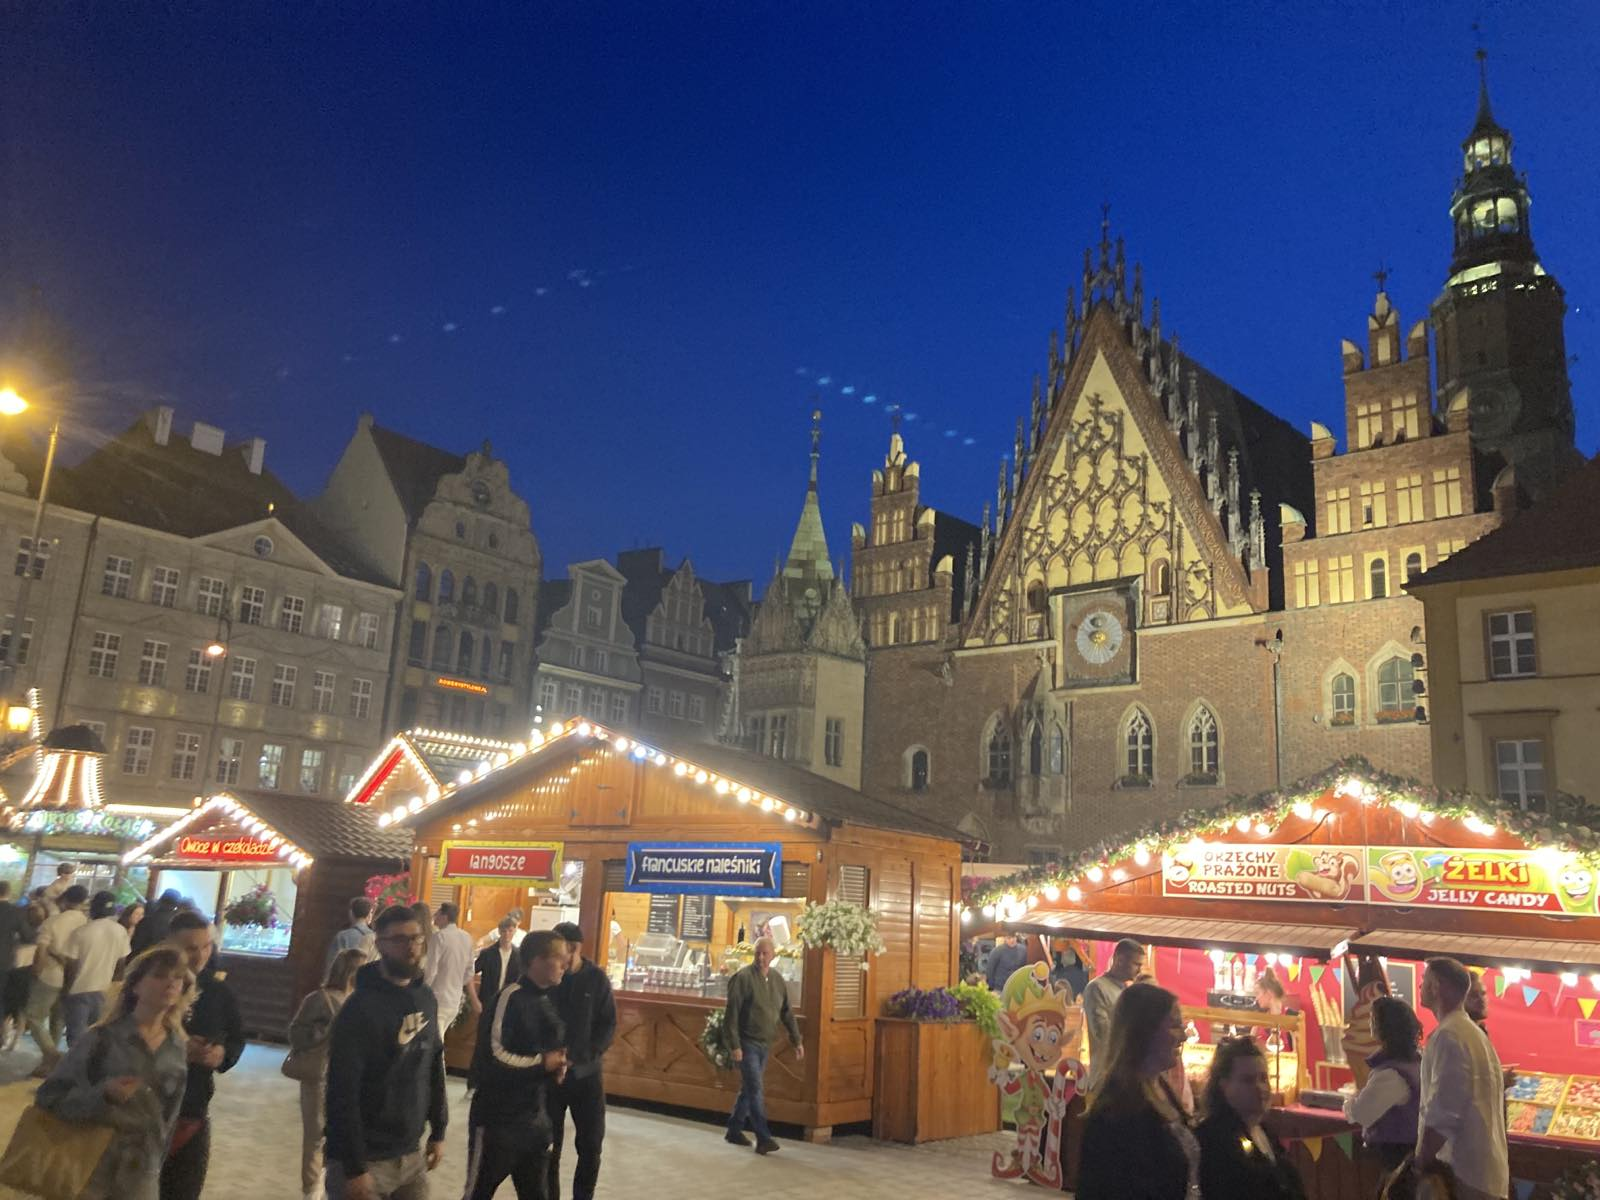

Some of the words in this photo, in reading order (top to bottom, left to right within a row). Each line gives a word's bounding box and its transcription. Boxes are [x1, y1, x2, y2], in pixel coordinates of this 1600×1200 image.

[181, 837, 210, 854] Owoce
[211, 841, 222, 854] w
[642, 855, 704, 873] francuskie
[706, 855, 761, 875] naleśniki
[1204, 851, 1276, 864] ORZECHY
[1204, 862, 1280, 878] PRAŻONE
[1187, 881, 1254, 896] ROASTED
[1256, 883, 1297, 896] NUTS
[1427, 889, 1479, 904] JELLY
[1484, 892, 1550, 908] CANDY
